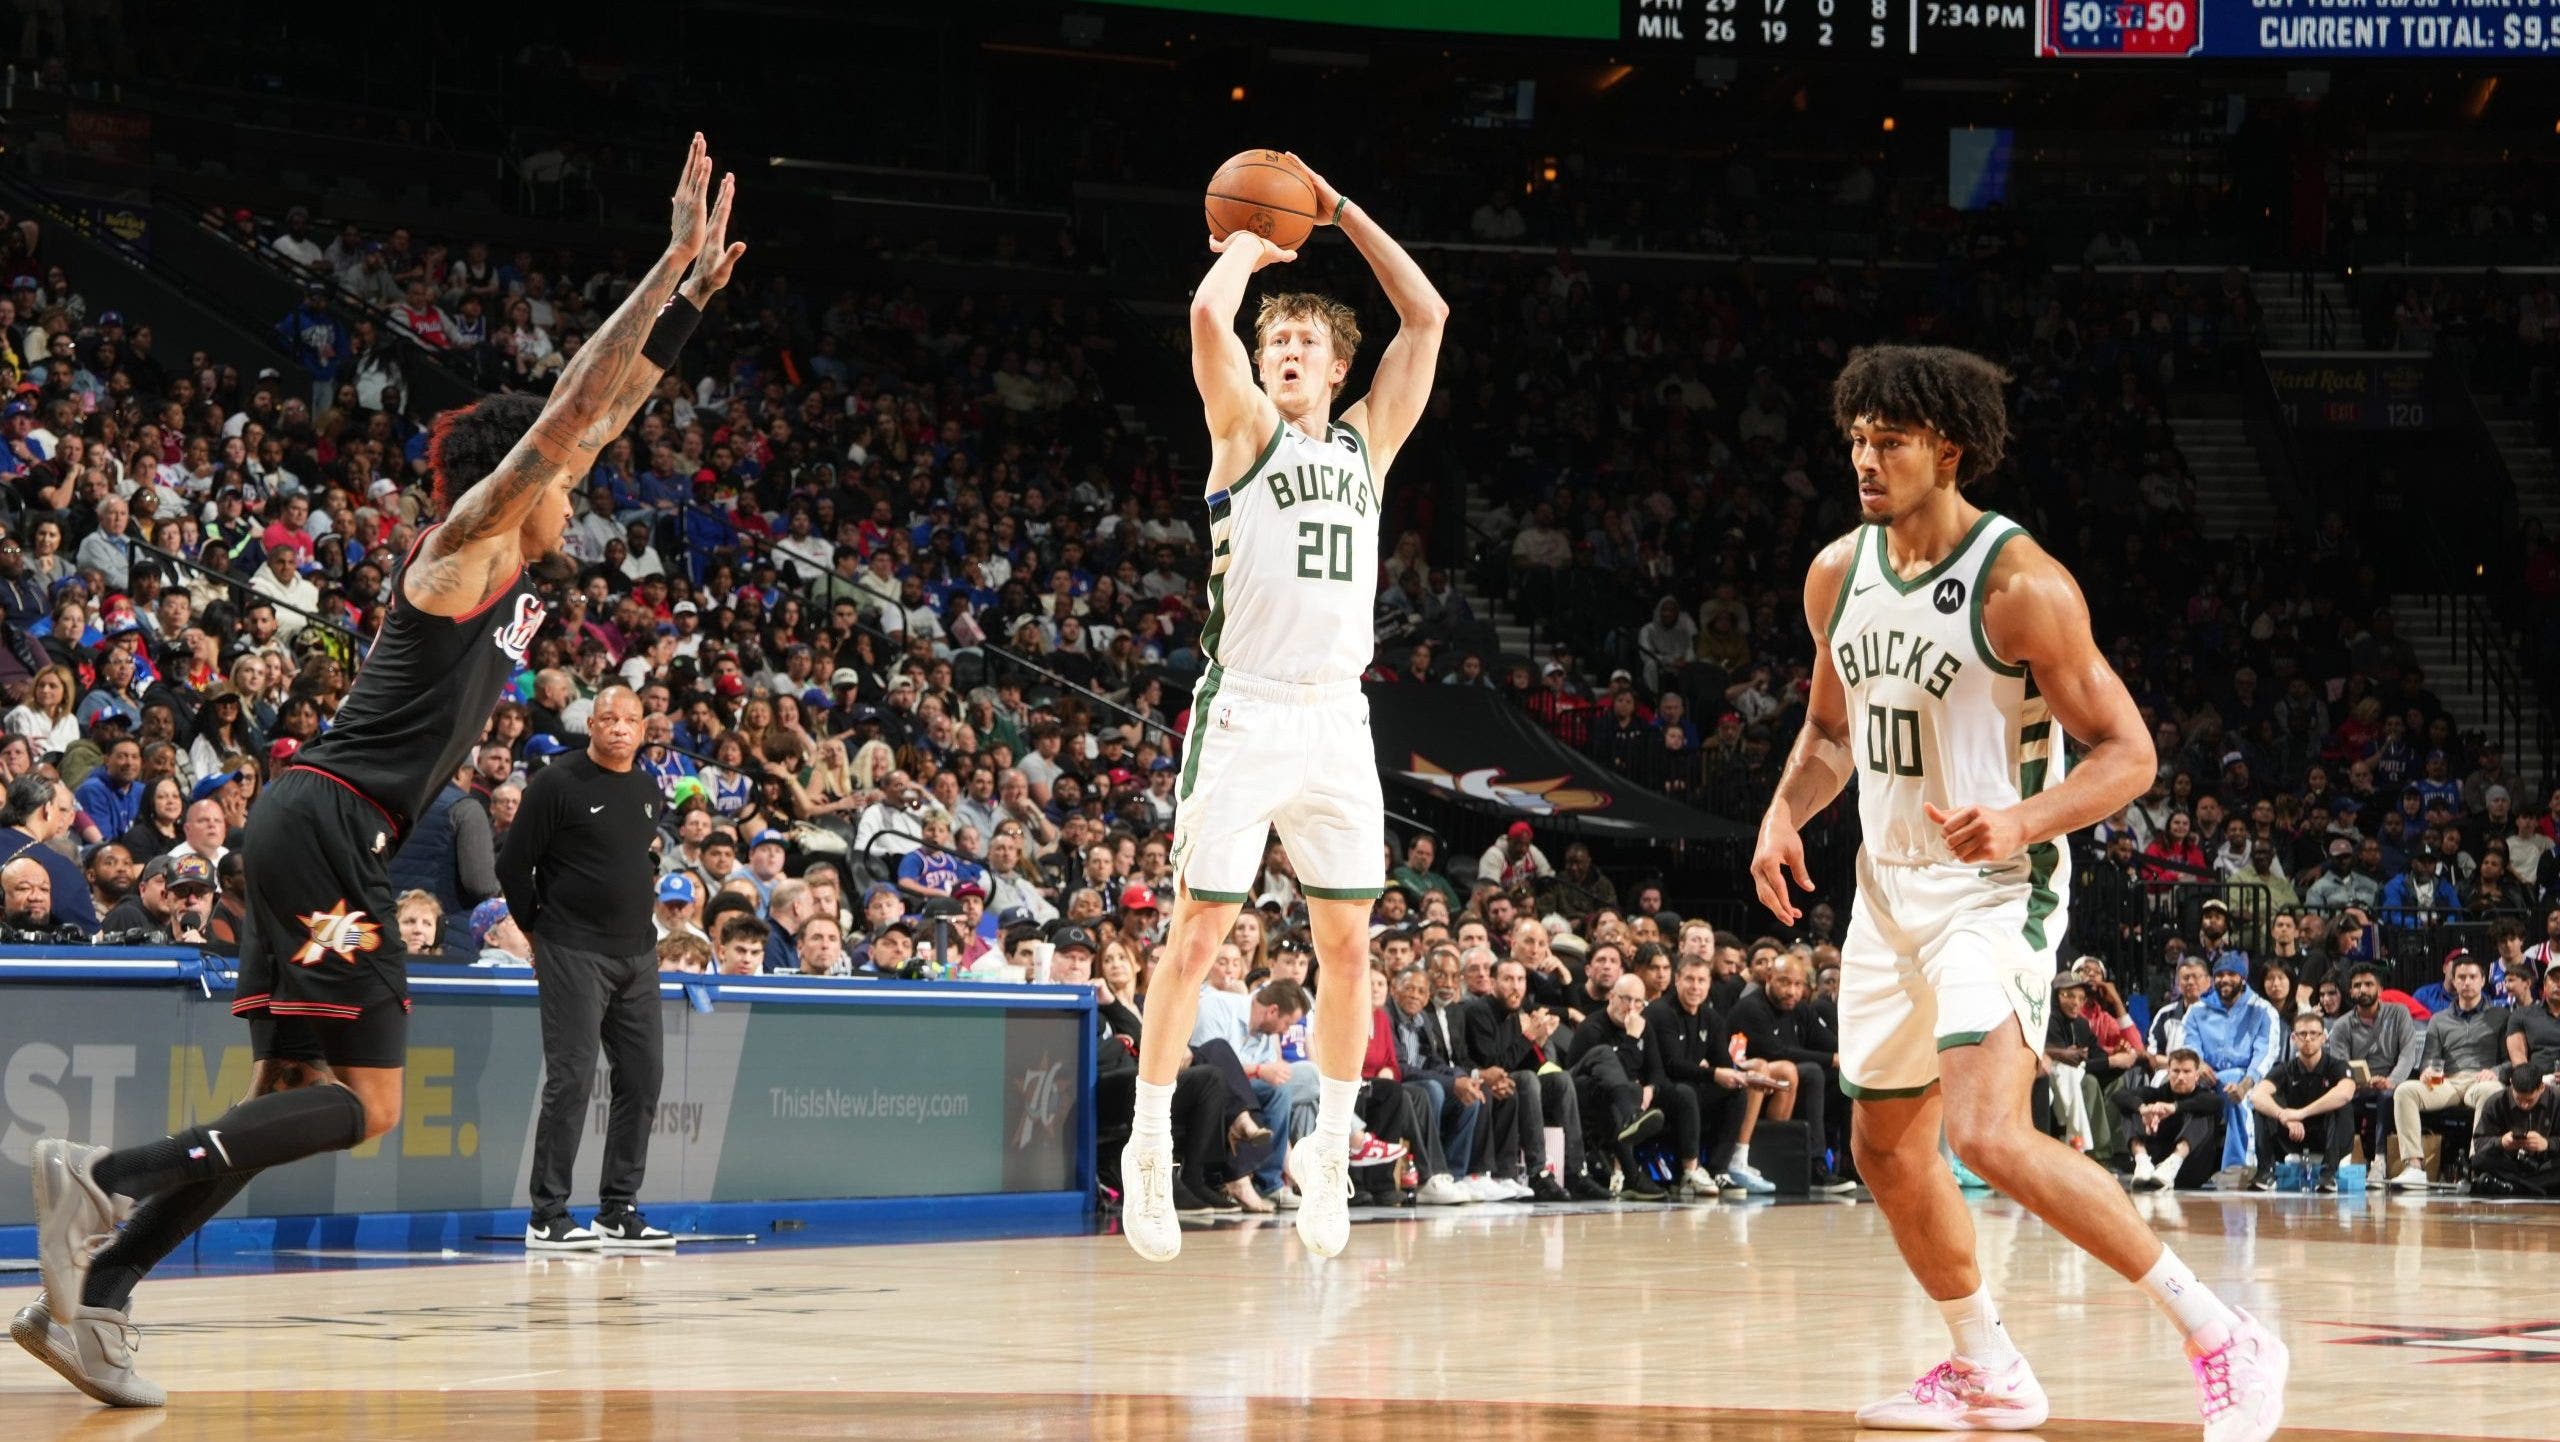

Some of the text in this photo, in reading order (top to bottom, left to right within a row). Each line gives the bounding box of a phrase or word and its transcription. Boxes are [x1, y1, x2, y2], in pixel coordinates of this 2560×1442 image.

[1871, 0, 1887, 19] 8
[1926, 3, 2025, 28] 7:34 PM
[2063, 1, 2101, 32] 50
[2147, 1, 2186, 32] 50
[1638, 15, 1885, 48] MIL 26 19 2 5
[2260, 16, 2390, 48] CURRENT
[2401, 16, 2495, 48] TOTAL:
[2321, 368, 2368, 394] Rock
[2387, 404, 2424, 428] 120
[1267, 464, 1368, 518] BUCKS
[1297, 521, 1353, 582] 20
[1838, 630, 1963, 701] BUCKS
[1867, 703, 1924, 777] 00
[302, 911, 367, 966] 76
[167, 1045, 478, 1158] ME.
[769, 1087, 969, 1124] ThisIsNewJersey.com
